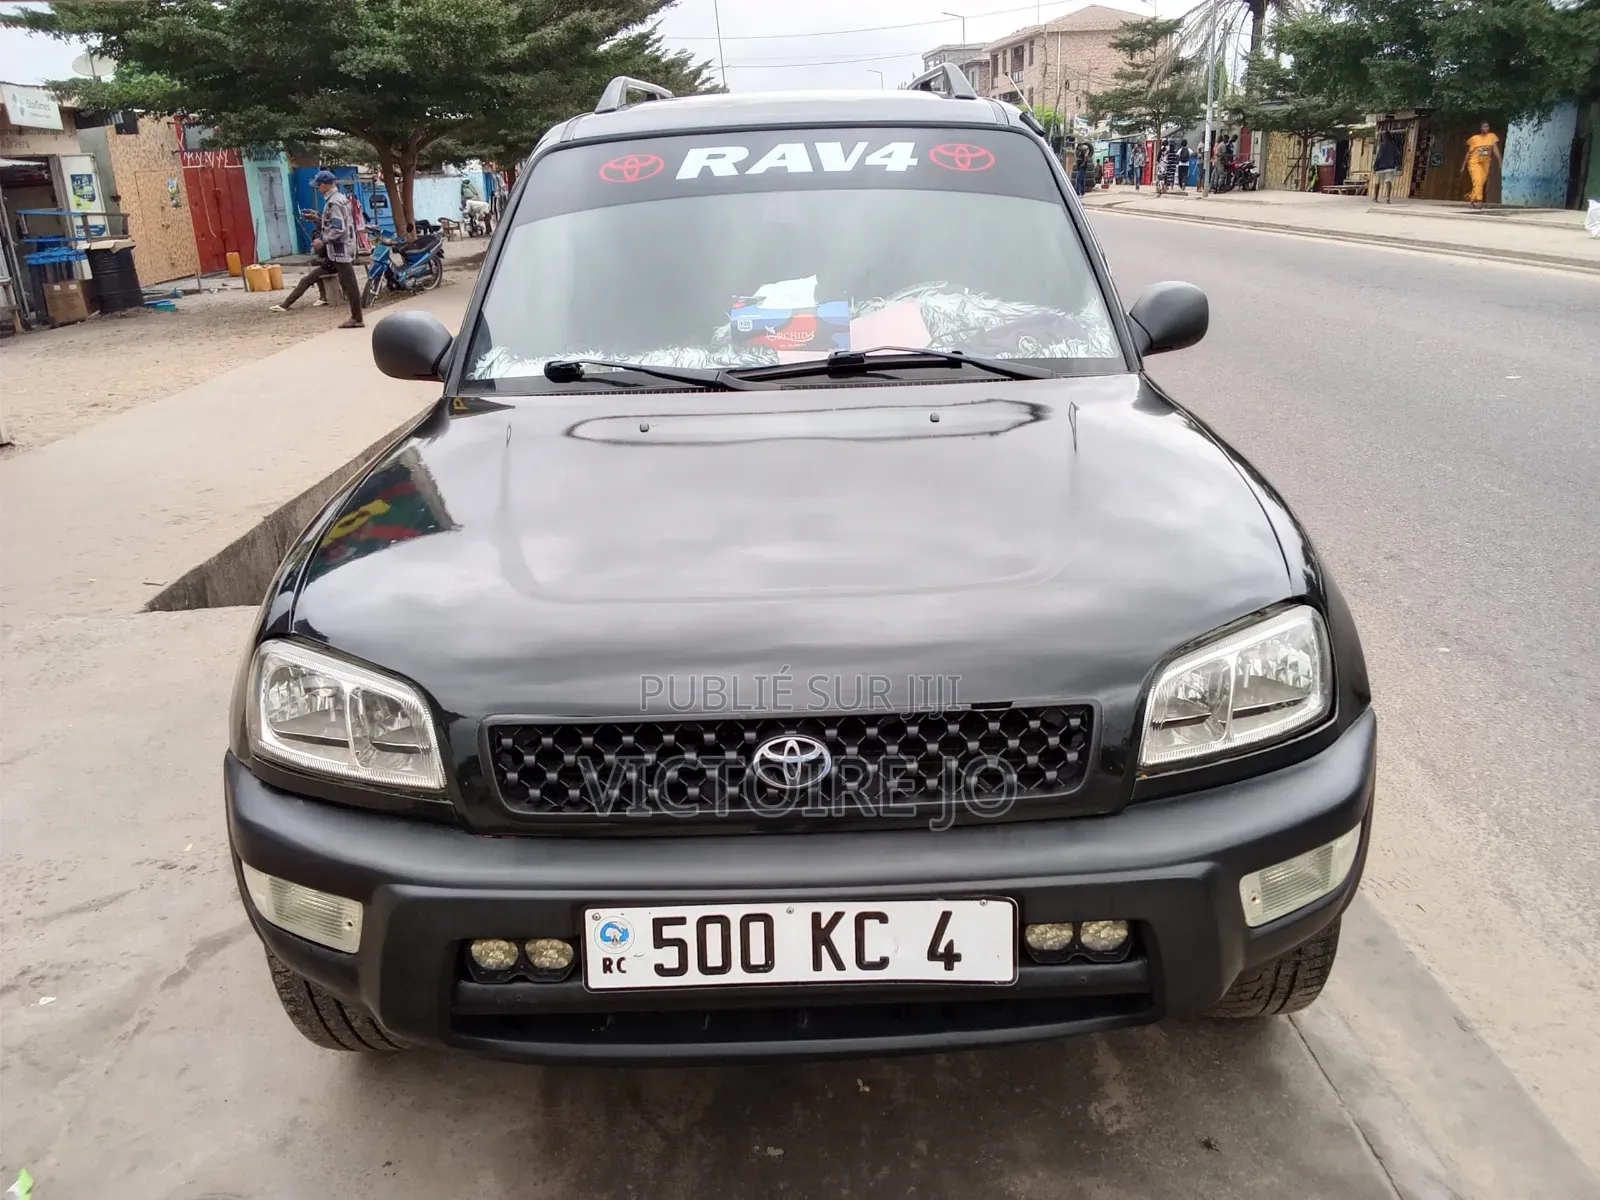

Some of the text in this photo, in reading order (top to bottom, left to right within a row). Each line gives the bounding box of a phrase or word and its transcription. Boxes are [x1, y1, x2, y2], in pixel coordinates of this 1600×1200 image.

[675, 141, 919, 180] RAV4
[652, 909, 963, 978] 500 KC 4
[601, 956, 628, 975] RC
